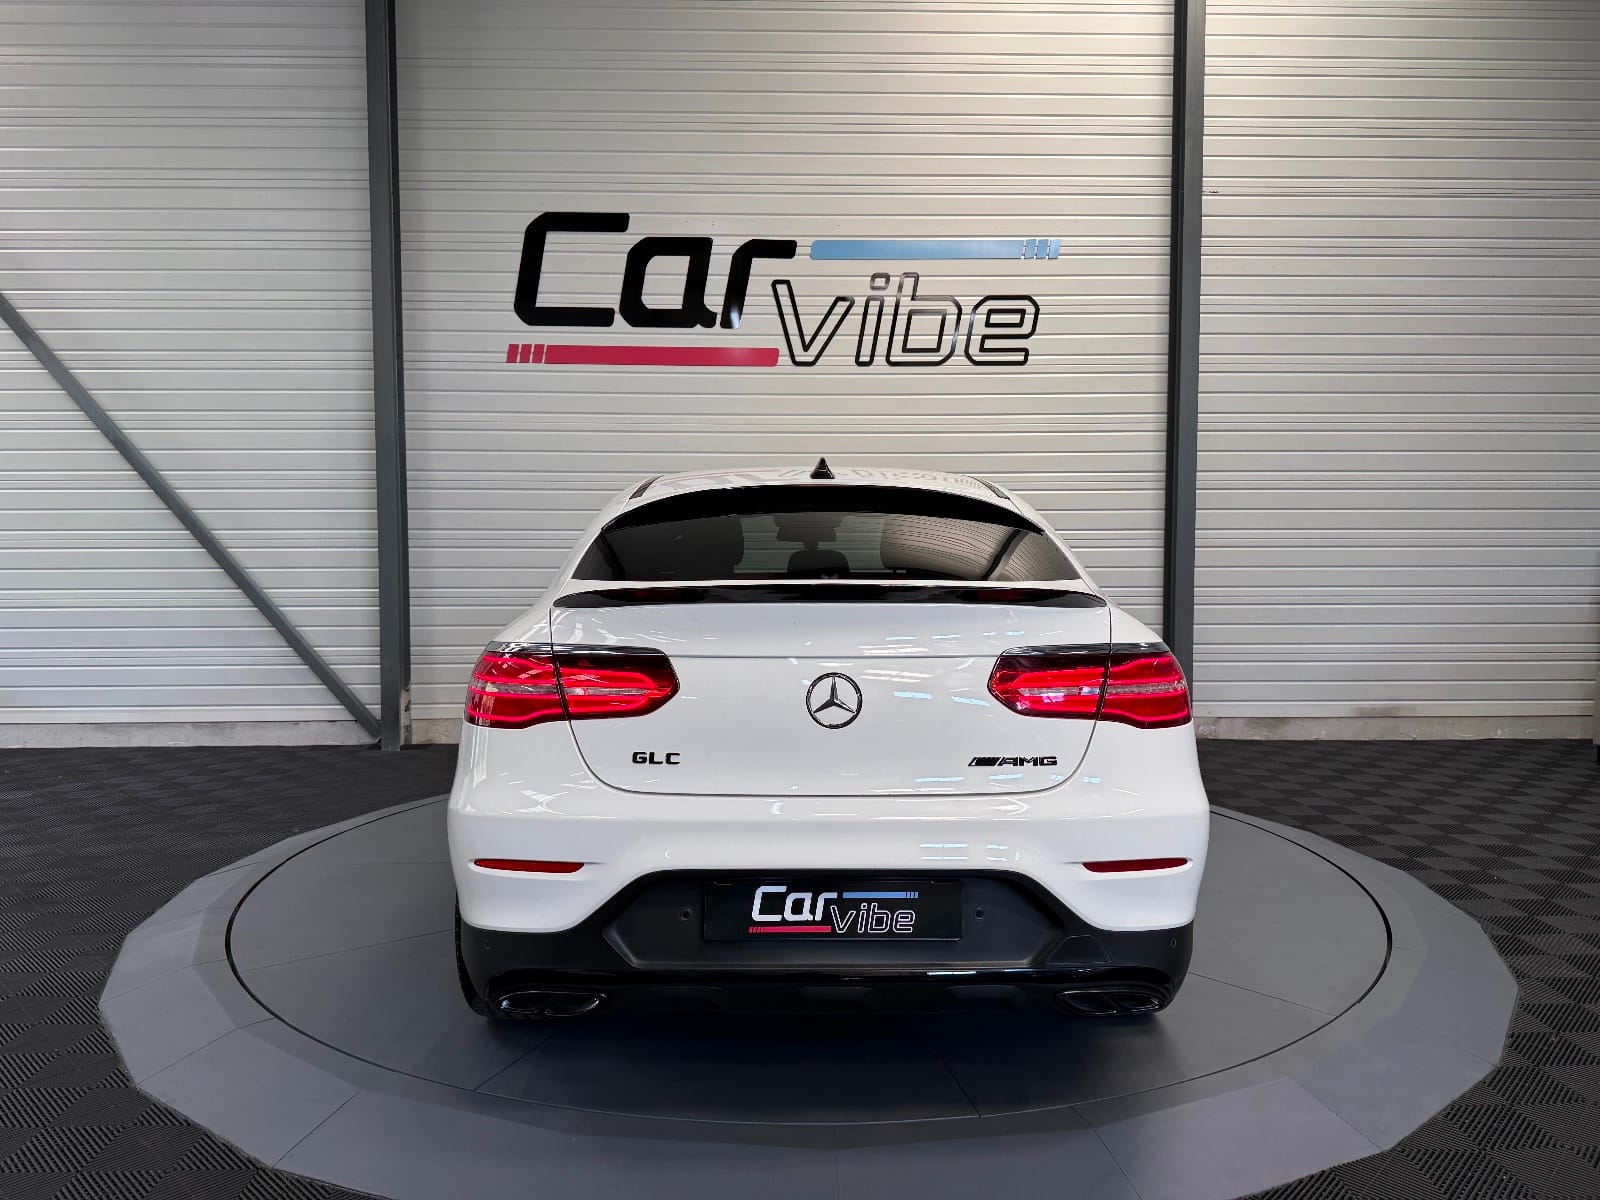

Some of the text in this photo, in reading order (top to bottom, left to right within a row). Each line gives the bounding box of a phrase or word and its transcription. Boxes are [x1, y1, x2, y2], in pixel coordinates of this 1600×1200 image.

[514, 212, 797, 328] Car
[771, 272, 1039, 366] vibe
[632, 751, 680, 764] GLC
[997, 756, 1057, 767] AMG
[751, 885, 837, 922] Car
[830, 902, 915, 933] vibe
